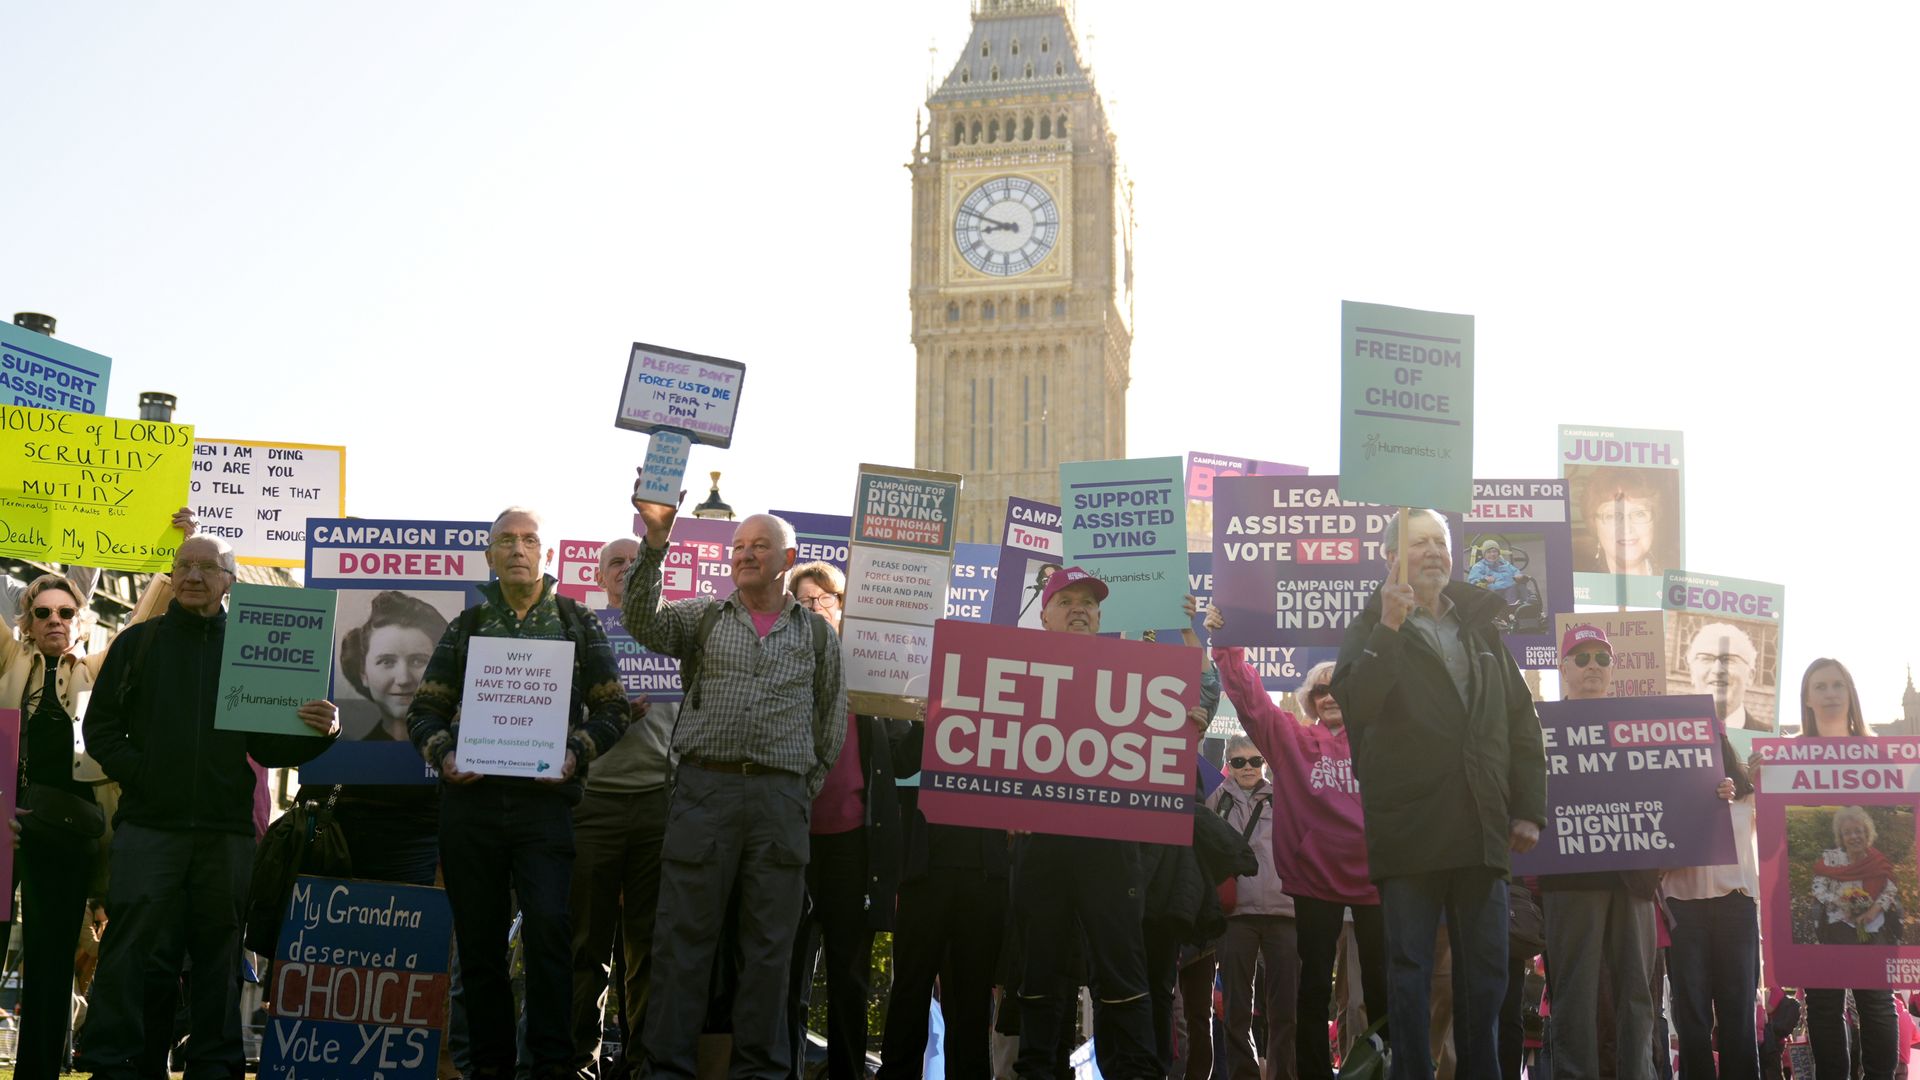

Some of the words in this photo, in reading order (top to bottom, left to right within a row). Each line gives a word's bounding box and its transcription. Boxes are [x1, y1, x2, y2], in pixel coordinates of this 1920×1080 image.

[1355, 339, 1461, 368] FREEDOM
[2, 353, 97, 395] SUPPORT
[643, 357, 690, 374] PLEASE
[1394, 367, 1423, 386] OF
[0, 371, 95, 414] ASSISTED
[639, 373, 675, 388] FORCE
[712, 388, 730, 400] DIE
[653, 391, 666, 400] IN
[669, 393, 699, 406] FEAR
[1365, 388, 1450, 413] CHOICE
[627, 408, 650, 420] LIKE
[653, 412, 680, 426] OUR
[682, 418, 729, 434] FRIENDS
[669, 406, 696, 418] PAIN
[86, 425, 103, 446] of
[114, 420, 191, 447] LORDS
[25, 442, 163, 471] SCRUTINY
[224, 446, 227, 456] I
[234, 447, 252, 458] AM
[268, 449, 303, 460] DYING
[1378, 441, 1436, 458] Humanists
[1438, 450, 1452, 459] UK
[223, 462, 250, 474] ARE
[1193, 457, 1227, 466] CAMPAIGN
[23, 480, 133, 505] MUTINY
[213, 482, 244, 494] TELL
[262, 487, 279, 498] ME
[290, 487, 320, 500] THAT
[870, 480, 922, 493] CAMPAIGN
[926, 486, 946, 496] FOR
[1472, 484, 1524, 496] PAIGN
[1530, 484, 1564, 496] FOR
[2, 498, 48, 513] Terminally
[73, 505, 100, 515] Adults
[868, 488, 944, 508] DIGNITY
[1074, 489, 1172, 509] SUPPORT
[198, 506, 234, 518] HAVE
[257, 509, 282, 522] NOT
[866, 502, 884, 515] IN
[888, 504, 948, 523] DYING.
[1072, 509, 1174, 530] ASSISTED
[866, 516, 940, 532] NOTTINGHAM
[1226, 515, 1356, 535] ASSISTED
[62, 529, 84, 559] My
[96, 531, 175, 557] Decision
[314, 526, 436, 544] CAMPAIGN
[445, 529, 490, 546] FOR
[865, 526, 892, 538] AND
[897, 530, 938, 544] NOTTS
[1014, 528, 1050, 550] Tom
[1093, 531, 1156, 549] DYING
[1224, 542, 1292, 561] VOTE
[1303, 541, 1354, 560] YES
[339, 553, 464, 576] DOREEN
[872, 560, 900, 570] PLEASE
[902, 564, 928, 573] DON'T
[866, 572, 890, 581] FORCE
[906, 576, 916, 584] TO
[918, 578, 931, 586] DIE
[1100, 572, 1150, 582] Humanists
[1152, 571, 1166, 580] UK
[1277, 580, 1354, 590] CAMPAIGN
[1670, 576, 1704, 584] CAMPAIGN
[872, 585, 892, 593] FEAR
[894, 588, 912, 596] AND
[914, 590, 932, 599] PAIN
[950, 587, 990, 602] NITY
[1276, 592, 1373, 610] DIGNIT
[858, 596, 874, 604] LIKE
[876, 598, 893, 606] OUR
[896, 601, 928, 610] FRIENDS
[239, 610, 324, 630] FREEDOM
[1276, 611, 1302, 628] IN
[268, 630, 291, 644] OF
[1606, 621, 1654, 638] LIFE.
[240, 645, 314, 664] CHOICE
[507, 652, 532, 661] WHY
[484, 666, 502, 674] DID
[506, 667, 522, 676] MY
[525, 668, 551, 678] WIFE
[868, 670, 886, 678] and
[890, 670, 909, 680] IAN
[475, 679, 504, 688] HAVE
[506, 681, 521, 690] TO
[524, 682, 540, 691] GO
[542, 682, 558, 692] TO
[941, 652, 1074, 720] LET
[1095, 670, 1188, 732] US
[241, 694, 298, 706] Humanists
[477, 692, 552, 706] SWITZERLAND
[492, 715, 507, 725] TO
[510, 716, 534, 726] DIE?
[464, 736, 496, 746] Legalise
[498, 738, 530, 746] Assisted
[532, 740, 554, 749] Dying
[1567, 725, 1606, 746] ME
[1614, 721, 1710, 744] CHOICE
[935, 715, 1187, 786] CHOOSE
[1760, 744, 1878, 761] CAMPAIGN
[1578, 752, 1618, 773] MY
[1628, 748, 1714, 770] DEATH
[1792, 769, 1904, 790] ALISON
[934, 775, 1024, 795] LEGALISE
[1032, 784, 1121, 804] ASSISTED
[1130, 793, 1184, 810] DYING
[1555, 802, 1630, 816] CAMPAIGN
[1635, 801, 1663, 812] FOR
[1556, 812, 1664, 836] DIGNITY
[1558, 836, 1585, 854] IN
[1590, 832, 1676, 853] DYING.
[290, 883, 320, 929] My
[326, 885, 422, 928] Grandma
[289, 930, 396, 968] deserved
[406, 953, 418, 968] a
[1888, 975, 1900, 984] IN
[276, 962, 434, 1024] CHOICE
[274, 1020, 340, 1062] Vote
[350, 1024, 429, 1069] YES
